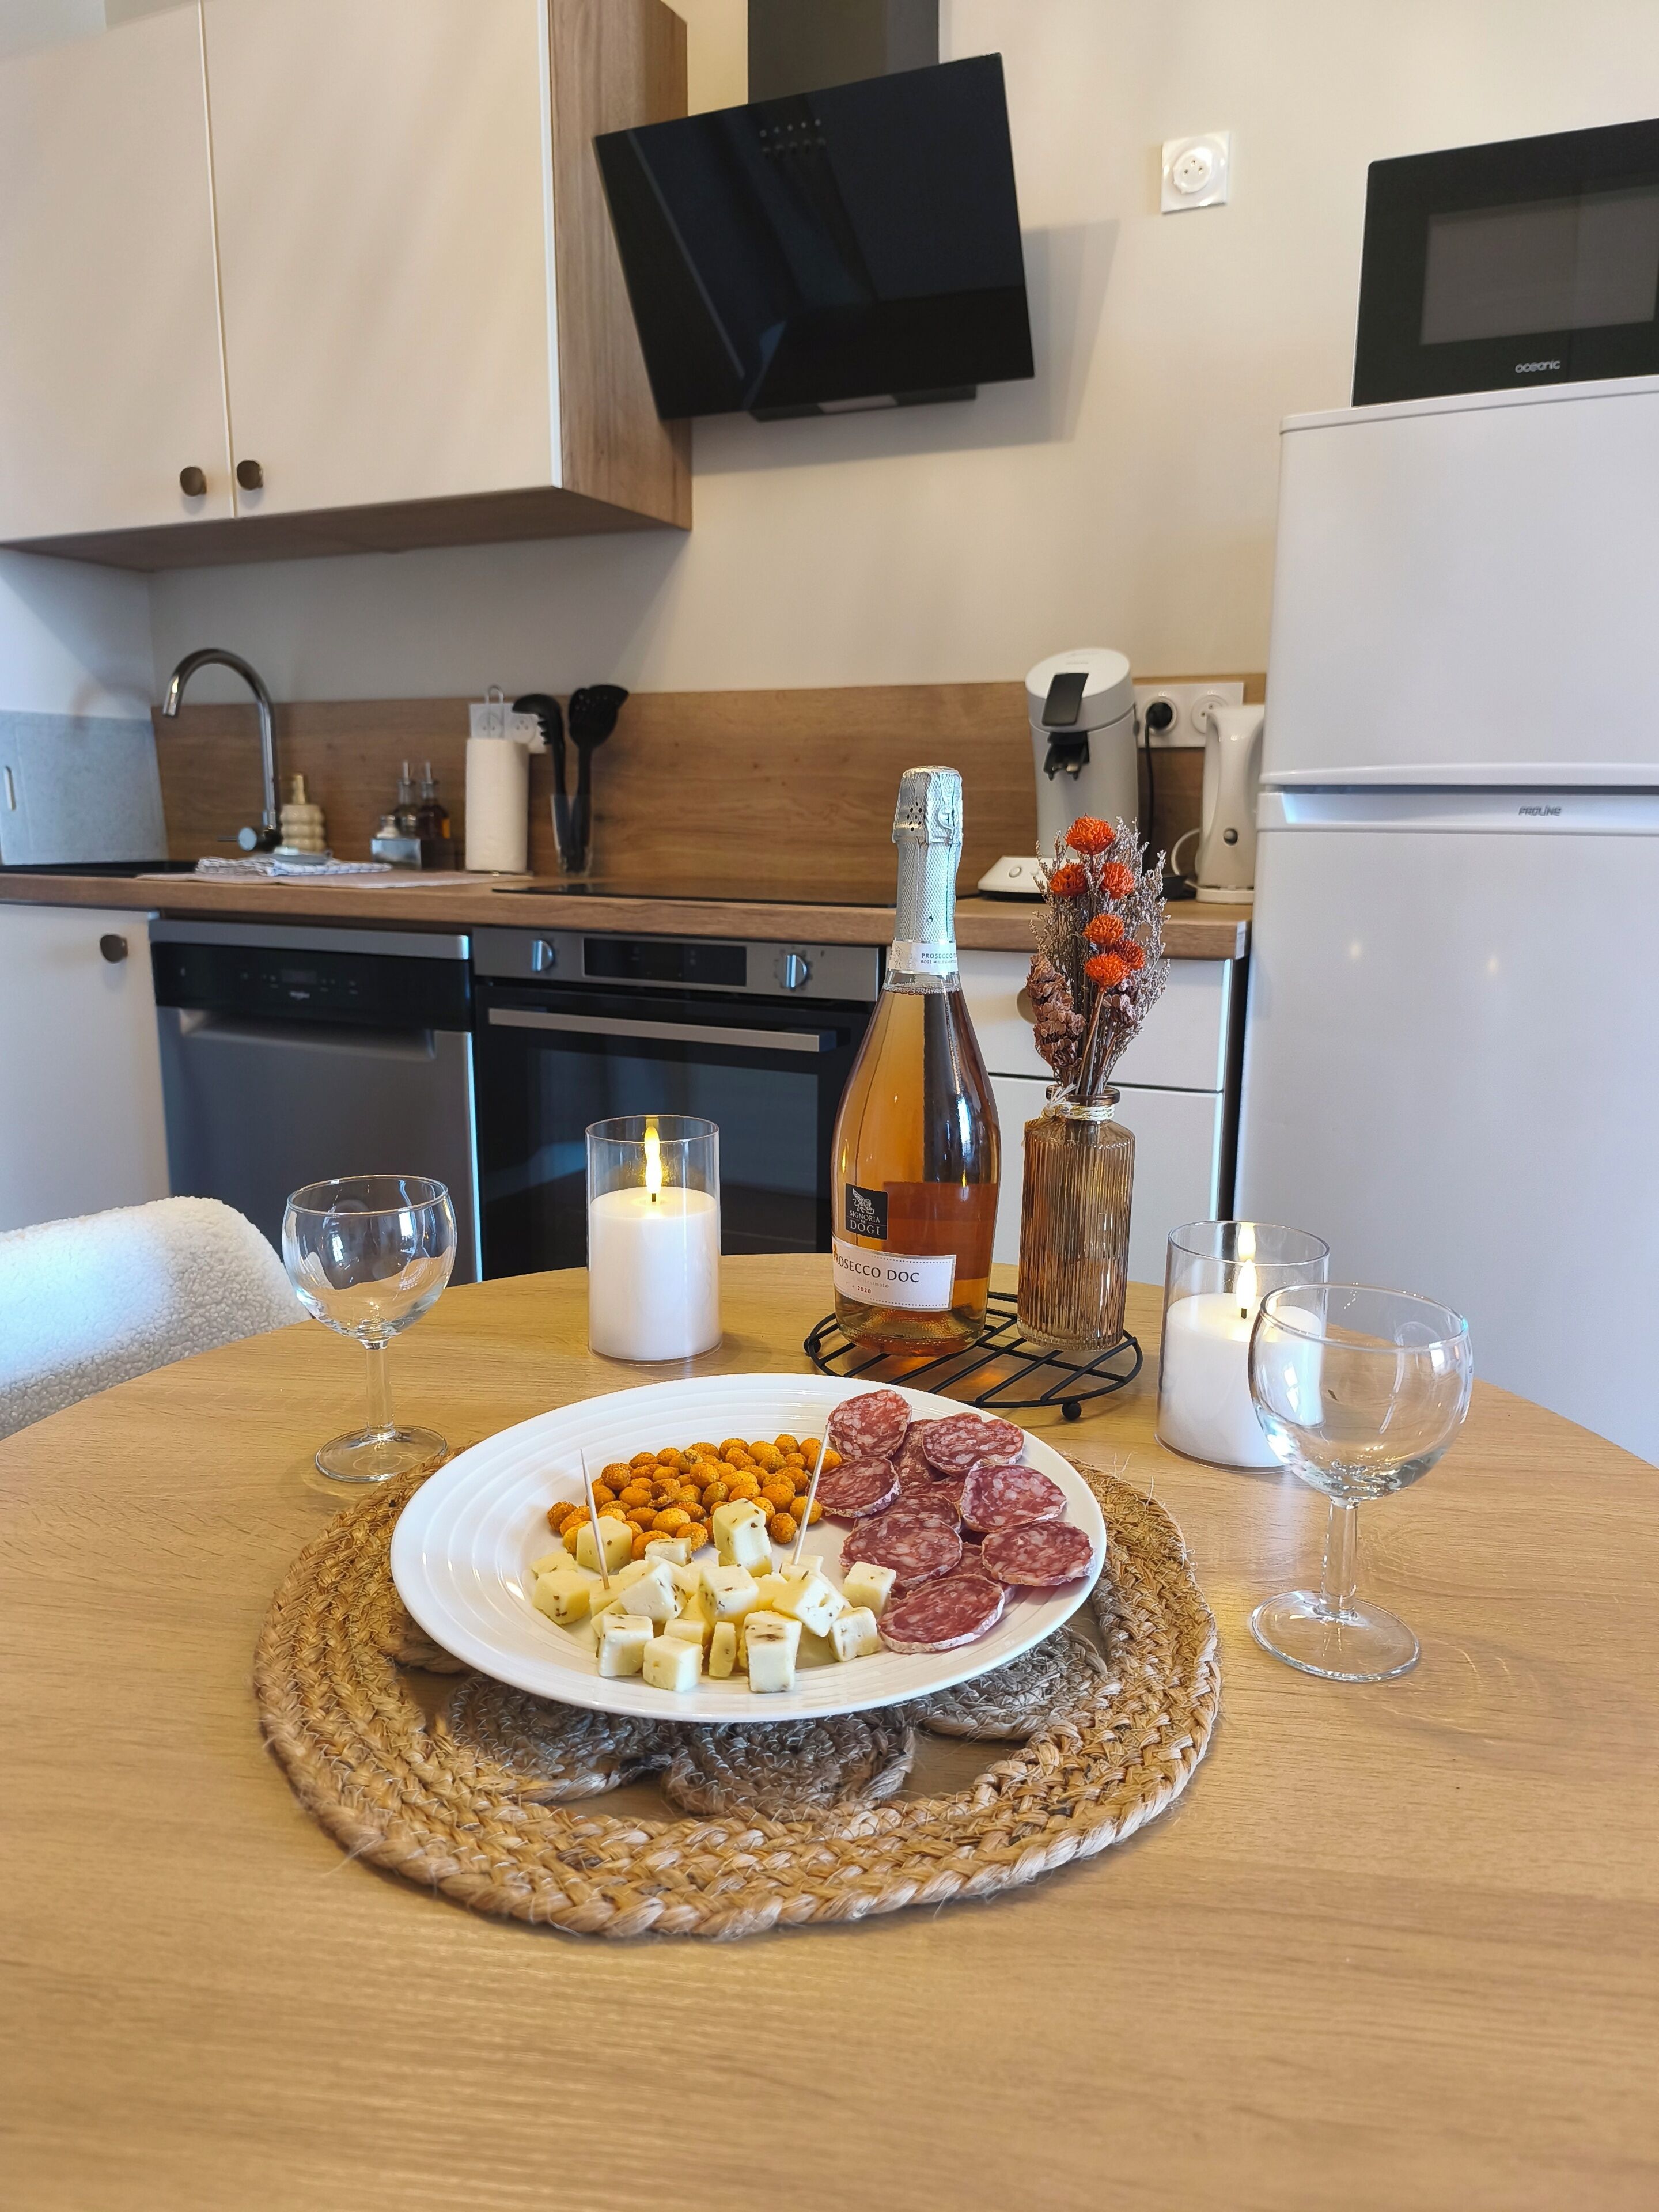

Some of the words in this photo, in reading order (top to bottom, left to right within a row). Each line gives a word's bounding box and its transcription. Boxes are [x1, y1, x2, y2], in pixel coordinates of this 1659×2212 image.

[1515, 359, 1561, 373] oceanic
[850, 1210, 880, 1223] SIGNORIA
[850, 1219, 880, 1236] DOGI
[833, 1250, 881, 1278] PROSECCO
[887, 1270, 919, 1283] DOC
[857, 1286, 872, 1294] 2020
